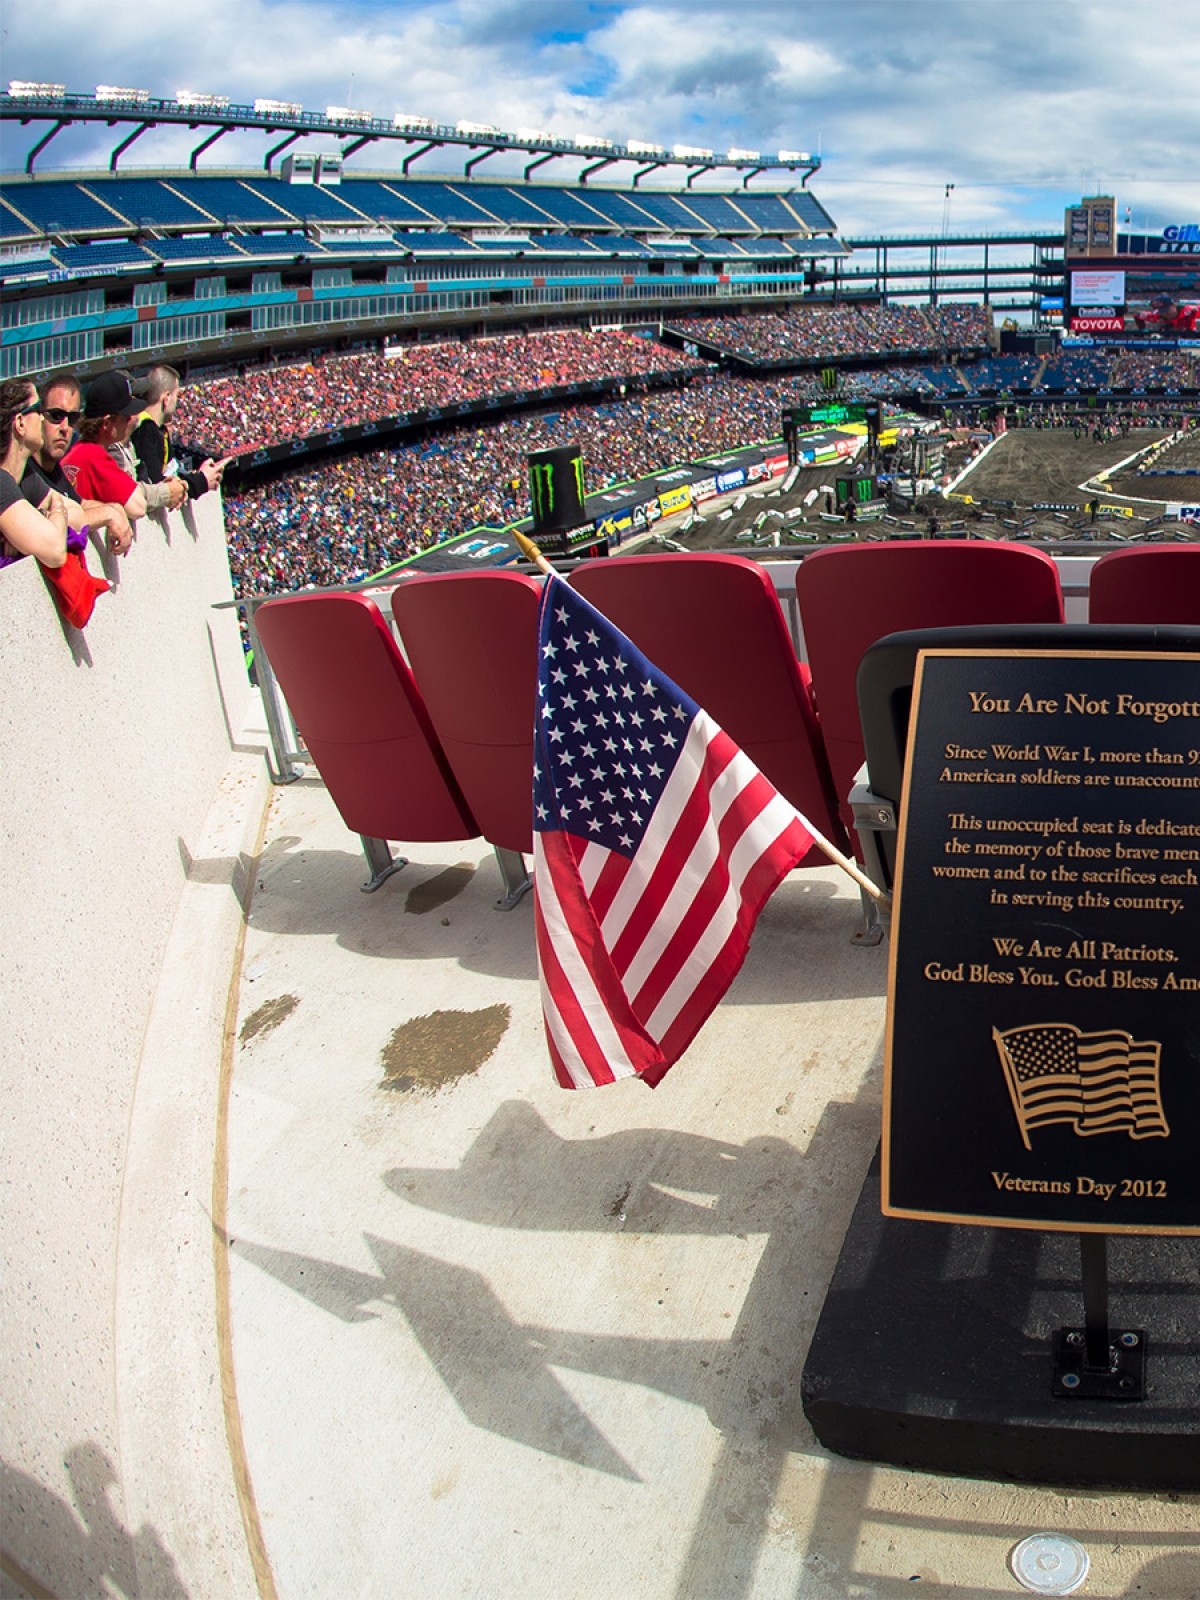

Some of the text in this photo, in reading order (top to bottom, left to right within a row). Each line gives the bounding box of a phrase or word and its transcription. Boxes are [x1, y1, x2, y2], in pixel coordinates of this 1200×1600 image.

[1072, 319, 1123, 331] TOYOTA
[969, 691, 1010, 713] You
[1016, 692, 1057, 714] Are
[1065, 692, 1109, 715] Not
[944, 743, 986, 760] Since
[991, 744, 1040, 761] World
[1043, 745, 1078, 762] War
[1083, 746, 1095, 763] I,
[1099, 751, 1141, 764] more
[1145, 748, 1184, 764] than
[939, 766, 1017, 784] American
[1020, 767, 1080, 785] soldiers
[1084, 773, 1110, 786] are
[948, 812, 982, 831] This
[985, 817, 1078, 836] unoccupied
[1082, 822, 1113, 834] seat
[1118, 820, 1132, 835] is
[944, 836, 971, 854] the
[974, 843, 1041, 861] memory
[1045, 840, 1066, 857] of
[1067, 841, 1111, 859] those
[1115, 842, 1159, 860] brave
[1163, 849, 1200, 861] men
[932, 865, 990, 879] women
[993, 863, 1025, 881] and
[1029, 866, 1047, 881] to
[1051, 864, 1077, 882] the
[1082, 867, 1156, 885] sacrifices
[1159, 868, 1198, 885] each
[990, 889, 1184, 914] in serving this country.
[993, 937, 1179, 962] We Are All Patriots.
[923, 961, 964, 982] God
[968, 963, 1014, 985] Bless
[1018, 966, 1059, 987] You.
[1064, 968, 1106, 988] God
[1112, 969, 1159, 990] Bless
[991, 1171, 1167, 1201] Veterans Day 2012
